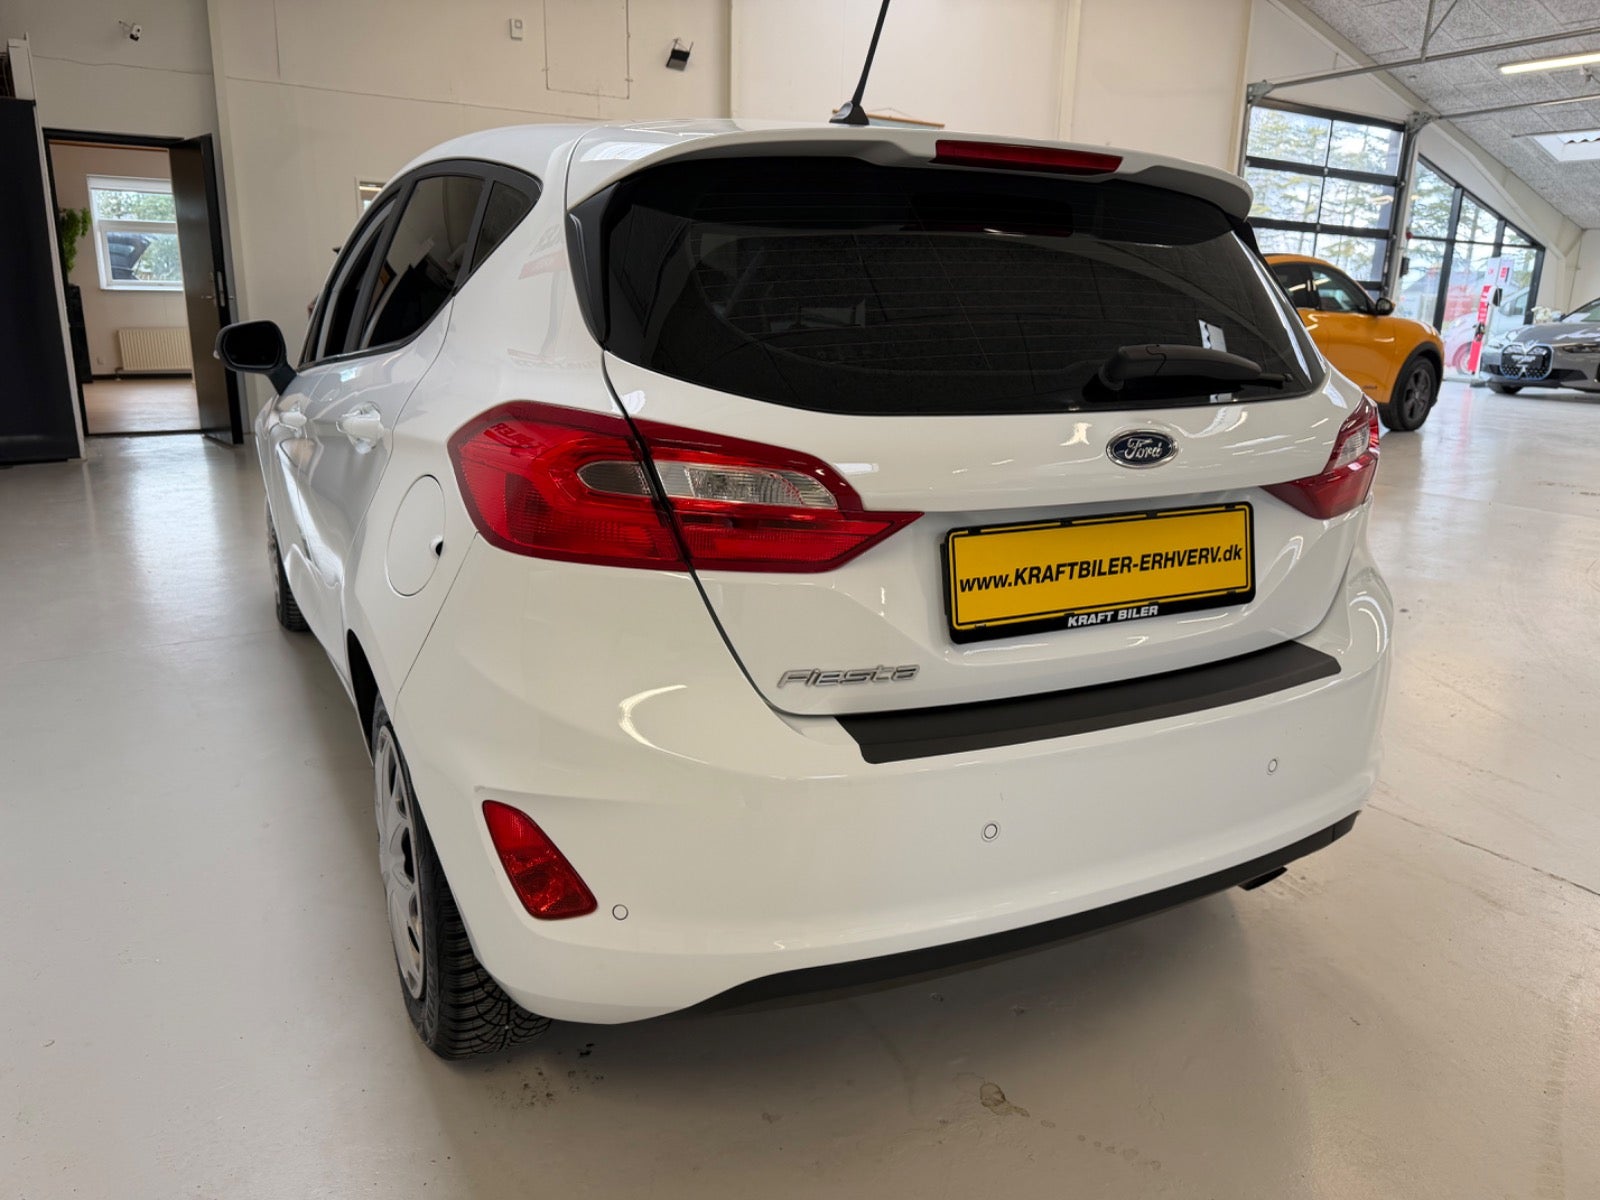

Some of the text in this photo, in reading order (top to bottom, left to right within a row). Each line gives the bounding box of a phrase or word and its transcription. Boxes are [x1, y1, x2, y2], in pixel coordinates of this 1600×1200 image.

[1124, 438, 1162, 459] Ford
[959, 544, 1243, 592] www.KRAFTBILER-ERHVERV.dk
[1067, 605, 1159, 627] KRAFT BILER
[777, 664, 920, 689] Fiesta
